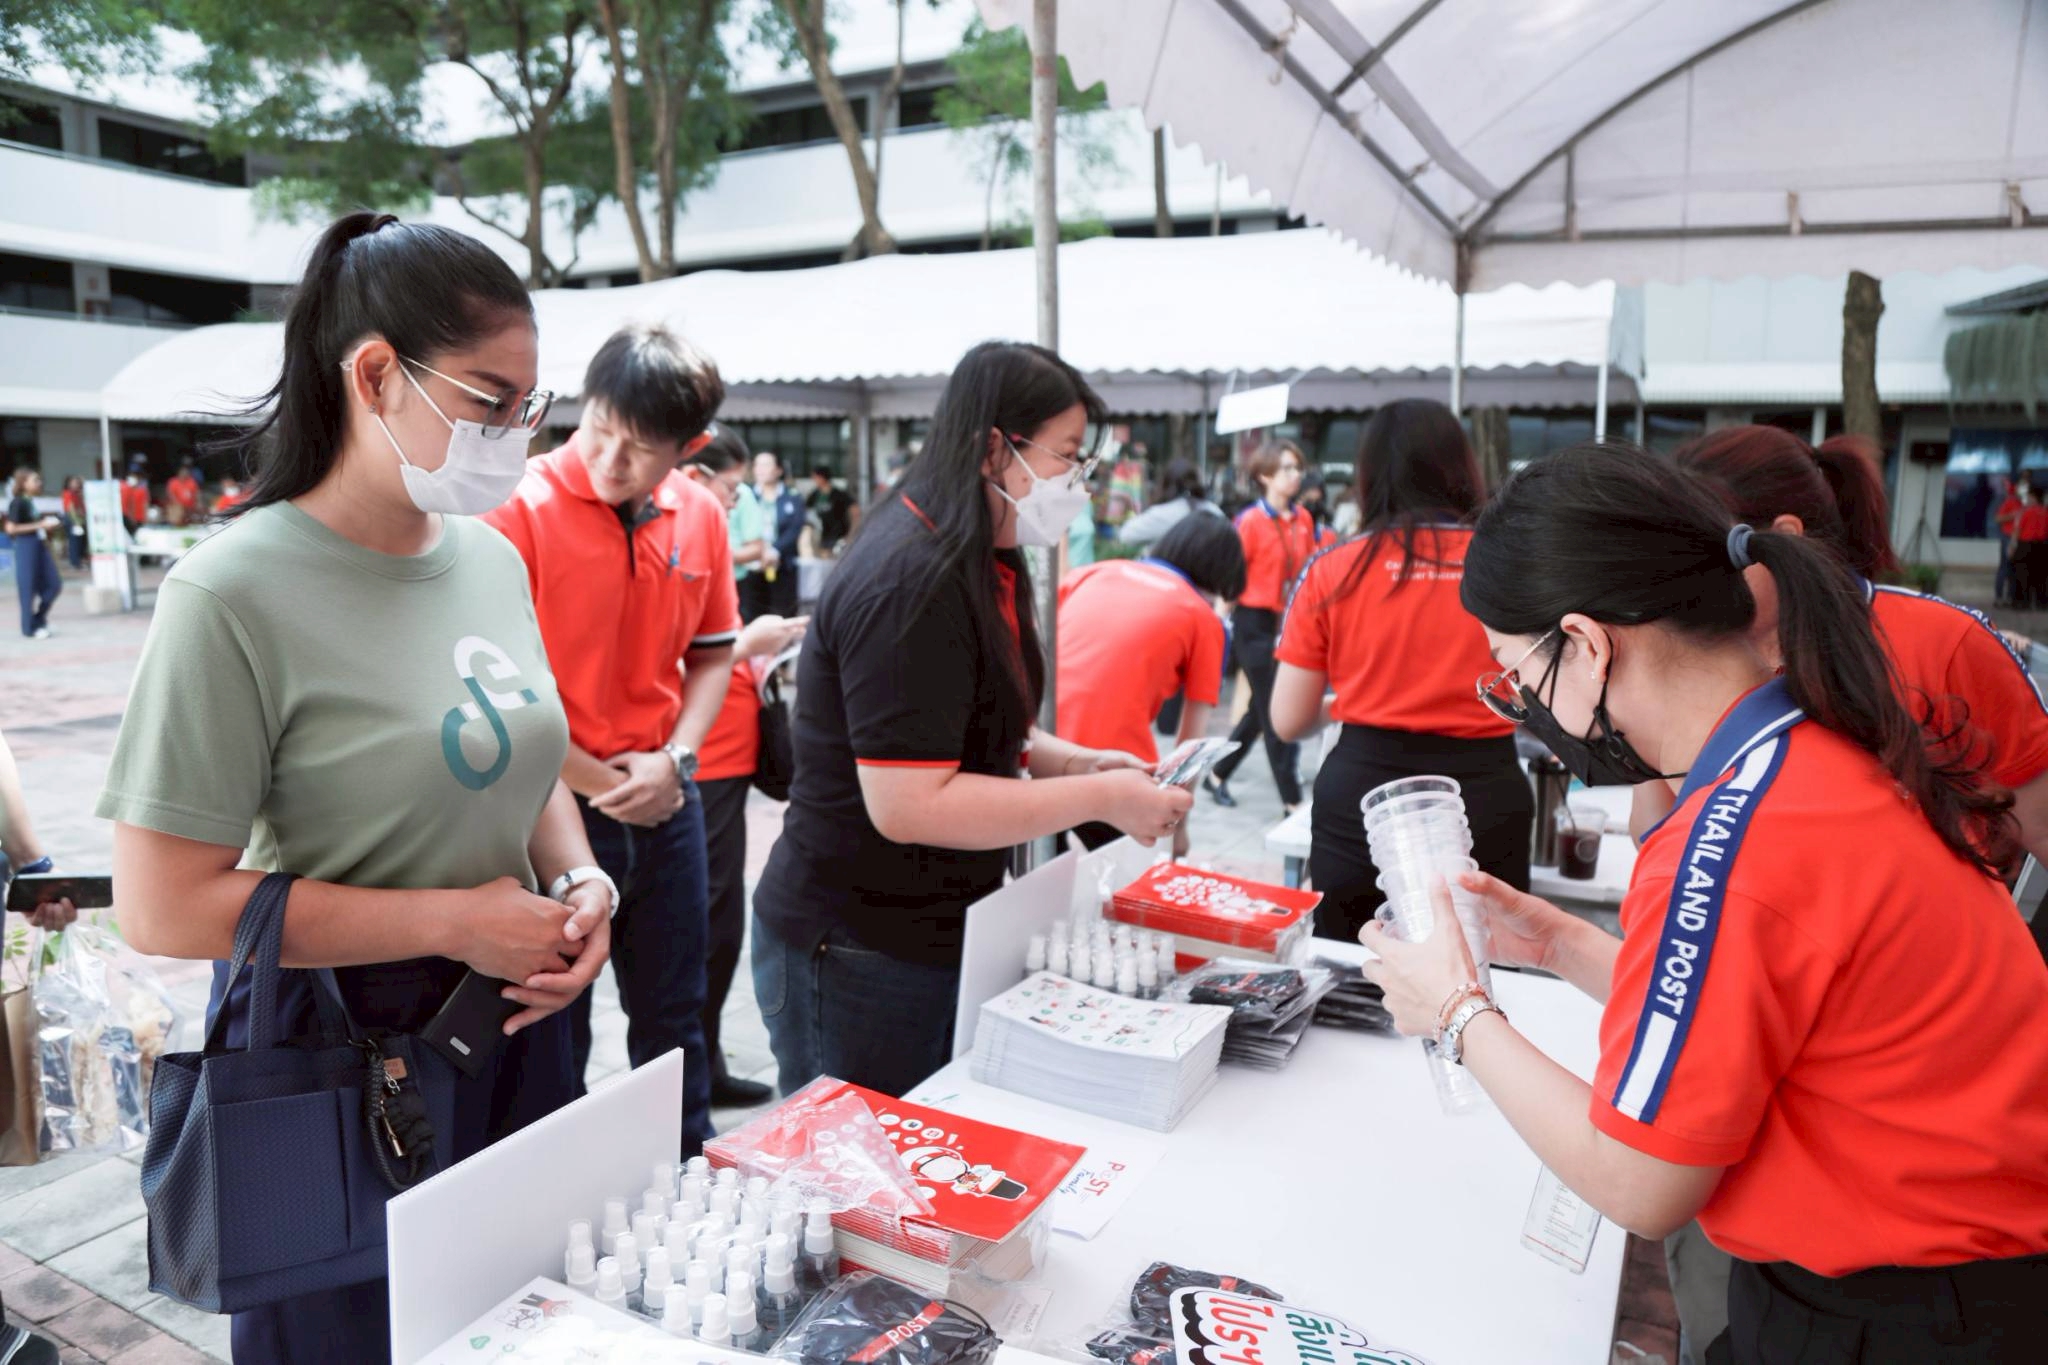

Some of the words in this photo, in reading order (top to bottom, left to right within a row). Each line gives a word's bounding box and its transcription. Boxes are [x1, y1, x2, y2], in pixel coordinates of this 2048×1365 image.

[1676, 793, 1748, 932] THAILAND
[1656, 939, 1700, 1016] POST
[886, 1314, 937, 1347] POST
